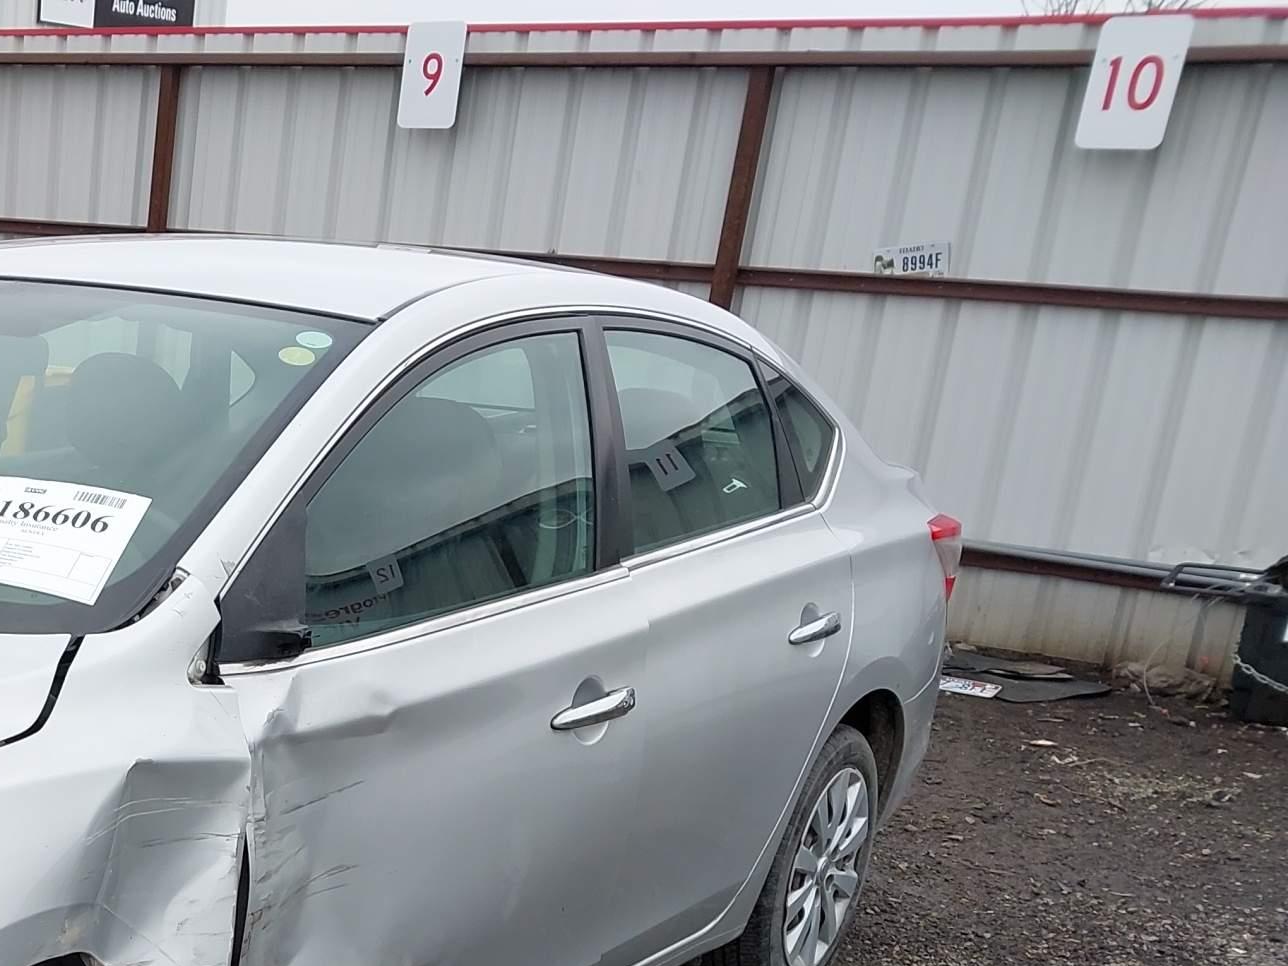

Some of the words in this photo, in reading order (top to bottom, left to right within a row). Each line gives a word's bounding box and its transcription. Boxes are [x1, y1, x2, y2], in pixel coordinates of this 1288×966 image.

[112, 0, 135, 15] Auto
[136, 0, 177, 22] Auctions
[422, 52, 443, 96] 9
[1100, 54, 1165, 112] 10
[901, 252, 943, 273] 8994F
